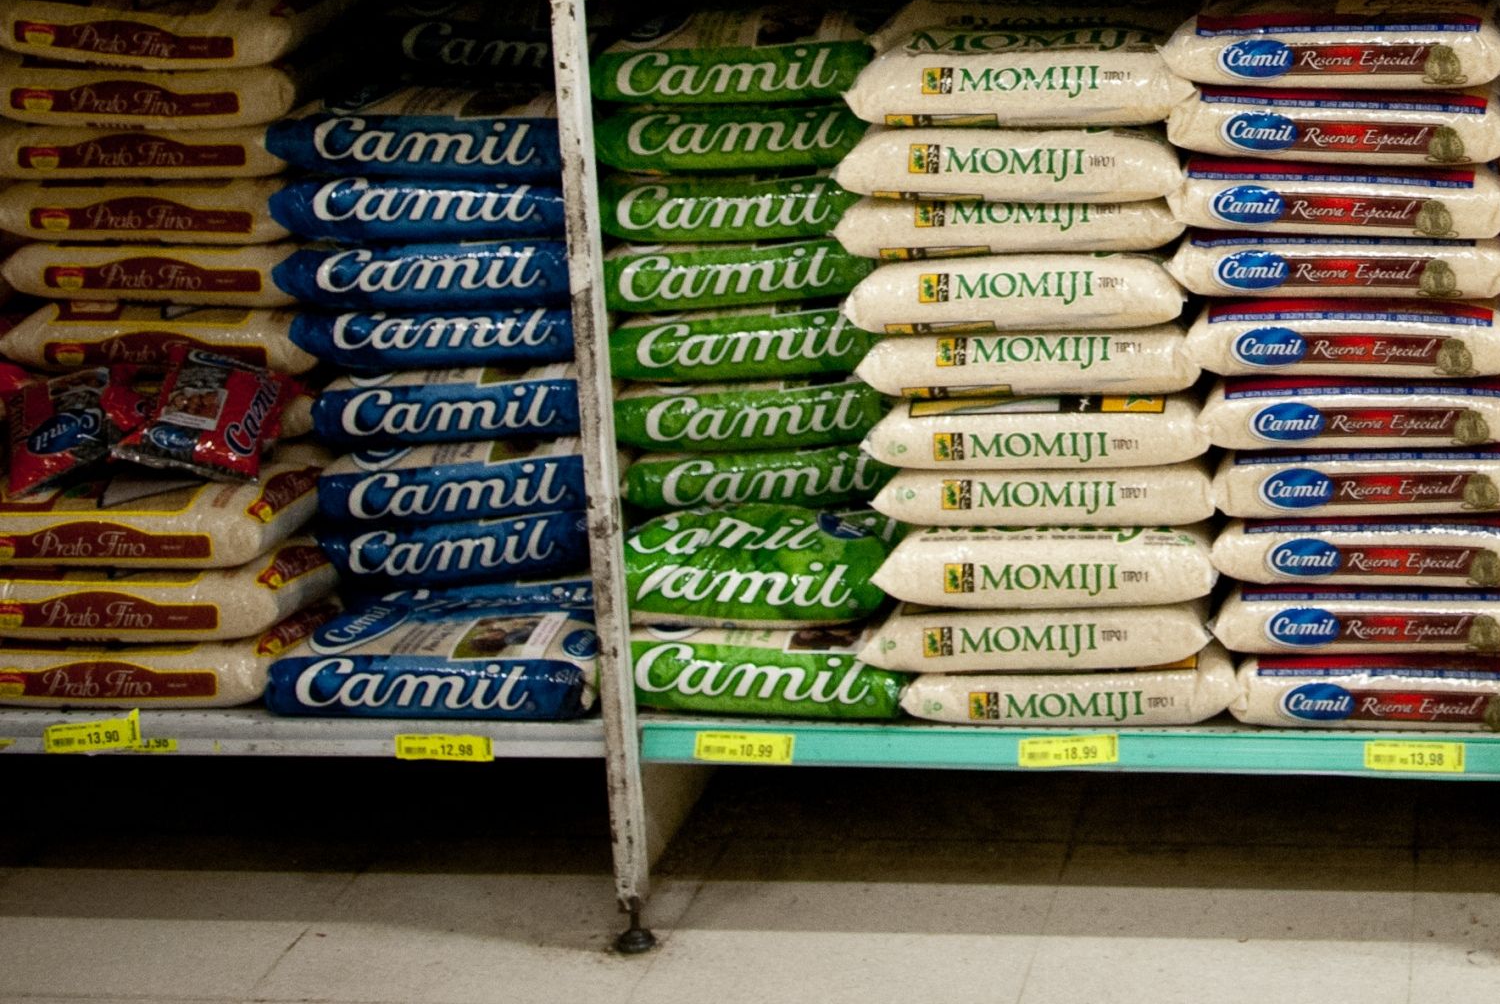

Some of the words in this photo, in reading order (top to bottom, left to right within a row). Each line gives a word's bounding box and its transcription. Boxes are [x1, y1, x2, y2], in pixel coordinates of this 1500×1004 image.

[617, 48, 837, 96] Camil
[1226, 49, 1288, 68] Camil
[1300, 50, 1353, 71] Reserva
[1359, 46, 1425, 73] Especial
[959, 65, 1101, 98] MOMIJI
[313, 118, 535, 165] Camil
[945, 147, 1085, 182] MOMIJI
[316, 246, 540, 293] Camil
[619, 247, 834, 302] Camil
[1222, 261, 1284, 281] Camil
[1295, 262, 1350, 284] Reserva
[1354, 260, 1421, 285] Especial
[341, 386, 557, 436] Camil
[970, 432, 1110, 463] MOMIJI
[1112, 438, 1133, 450] TIPO
[1267, 478, 1331, 498] Camil
[1340, 480, 1393, 502] Reserva
[1398, 473, 1463, 501] Especial
[33, 530, 92, 558] Prato
[98, 530, 146, 558] Fino
[981, 563, 1119, 596] MOMIJI
[1121, 569, 1142, 582] TIPO
[42, 598, 101, 628] Prato
[105, 600, 153, 628] Fino
[296, 658, 530, 711] Camil
[635, 644, 870, 705] Camil
[1288, 692, 1351, 713] Camil
[1361, 696, 1416, 717] Reserva
[1419, 695, 1484, 721] Especial
